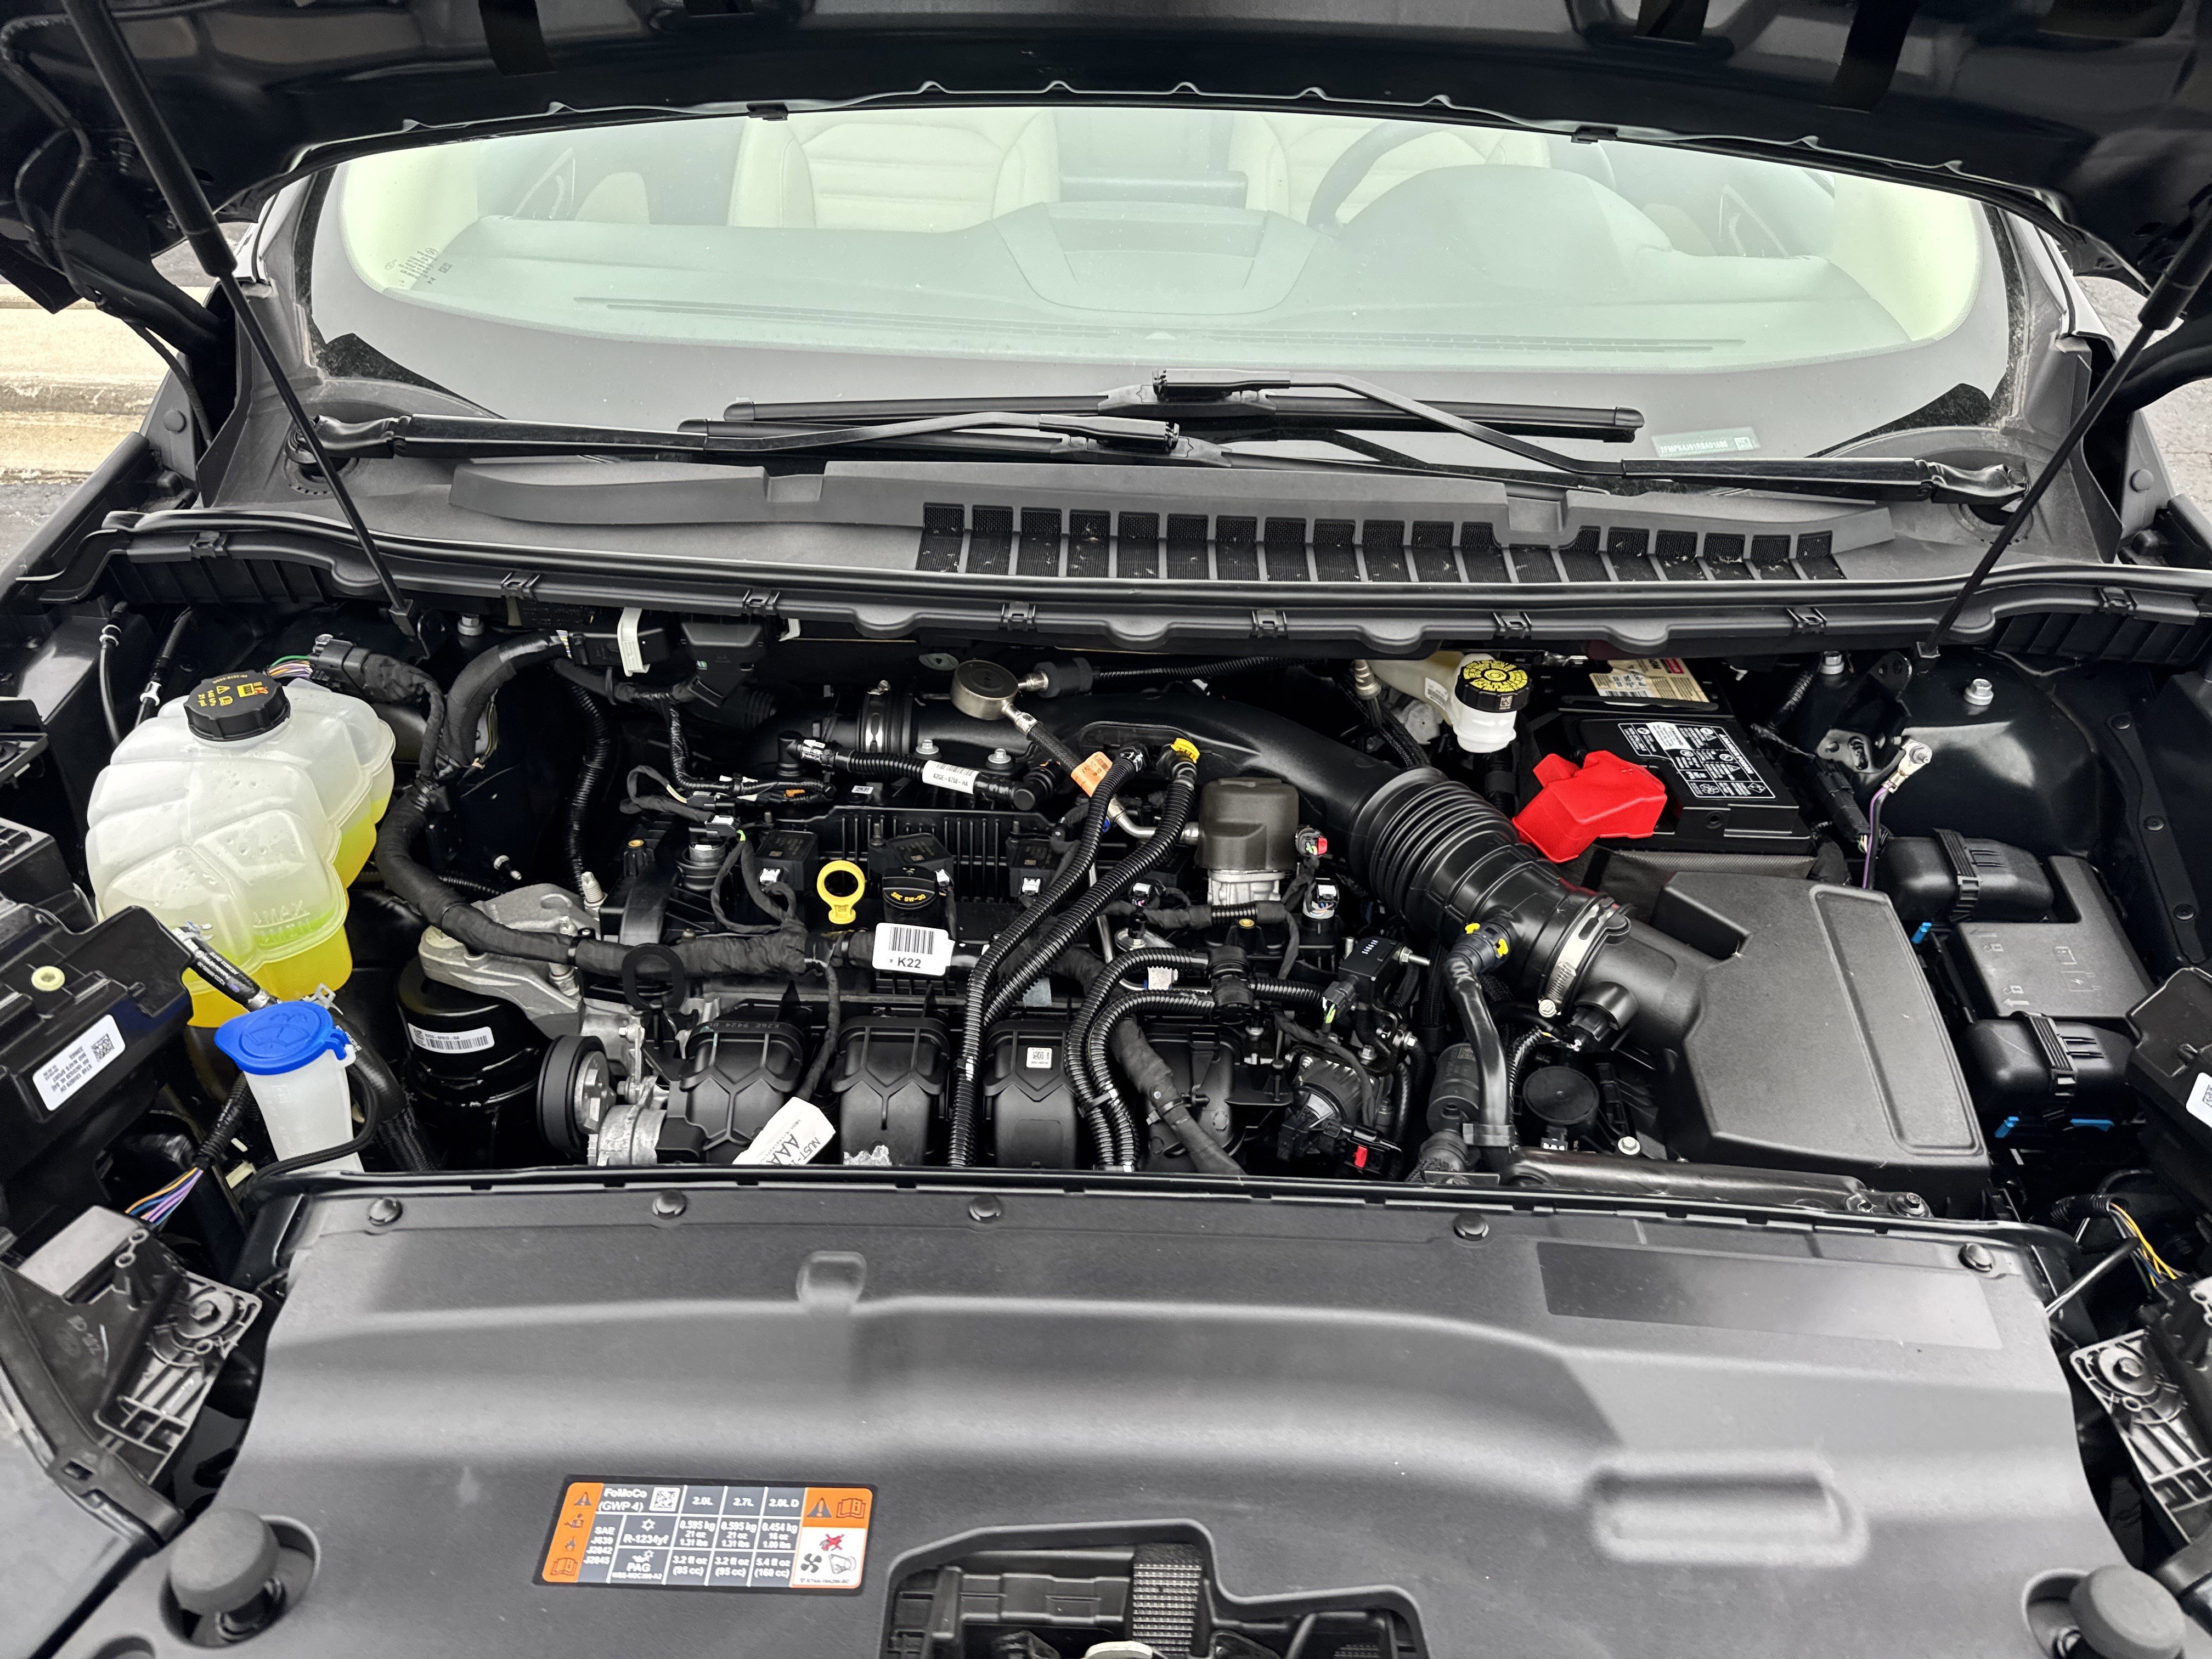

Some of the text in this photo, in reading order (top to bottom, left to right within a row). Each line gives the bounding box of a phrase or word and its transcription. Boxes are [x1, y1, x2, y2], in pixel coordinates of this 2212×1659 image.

[891, 891, 926, 902] SAE 5W-30
[897, 957, 922, 969] K22
[603, 1488, 647, 1498] FoMoCo
[598, 1500, 630, 1511] (GWP
[692, 1496, 713, 1505] 2.0L
[732, 1497, 754, 1506] 2.7L
[768, 1498, 799, 1508] 2.0L D
[594, 1526, 616, 1535] SAE
[704, 1521, 715, 1532] kg
[746, 1522, 757, 1533] kg
[787, 1523, 798, 1534] kg
[623, 1533, 669, 1545] R-1234yf
[672, 1555, 687, 1564] 3.2
[714, 1556, 729, 1565] 3.2
[755, 1558, 770, 1566] 5.4
[627, 1562, 651, 1572] PAG
